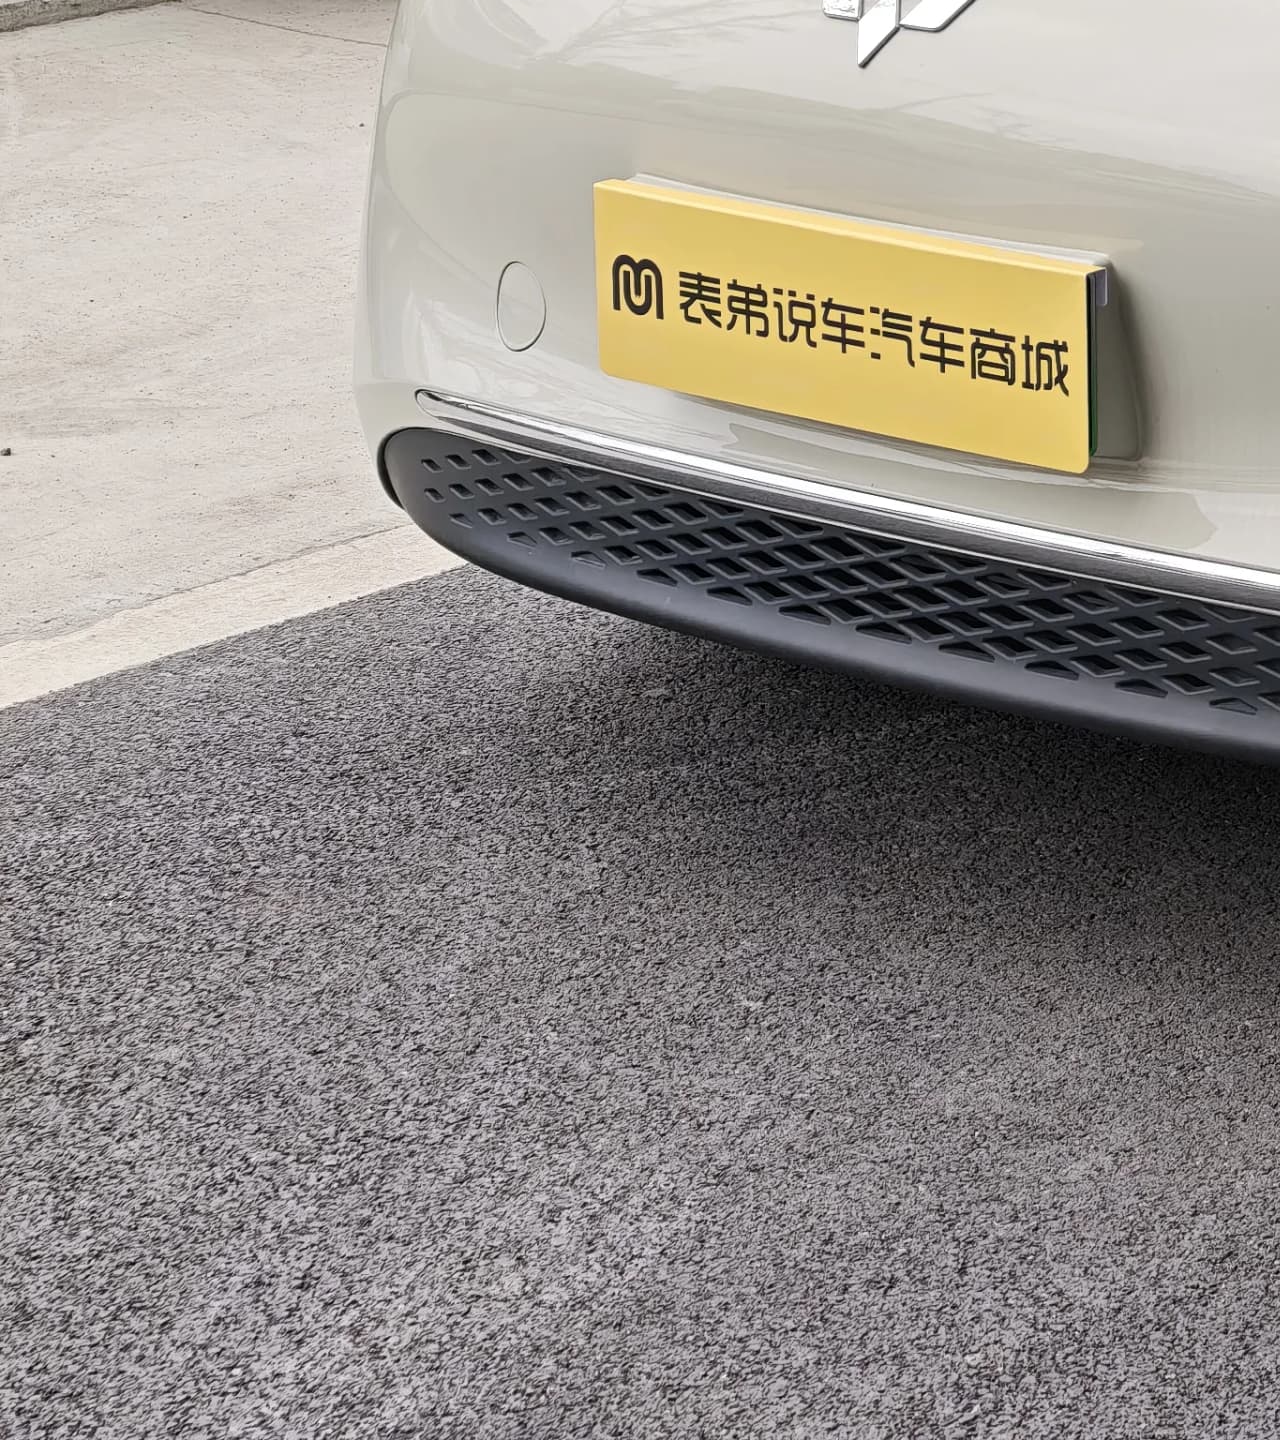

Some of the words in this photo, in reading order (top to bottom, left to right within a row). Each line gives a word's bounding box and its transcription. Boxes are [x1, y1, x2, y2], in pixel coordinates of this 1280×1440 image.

[679, 271, 1070, 397] 表弟说车汽车商城
